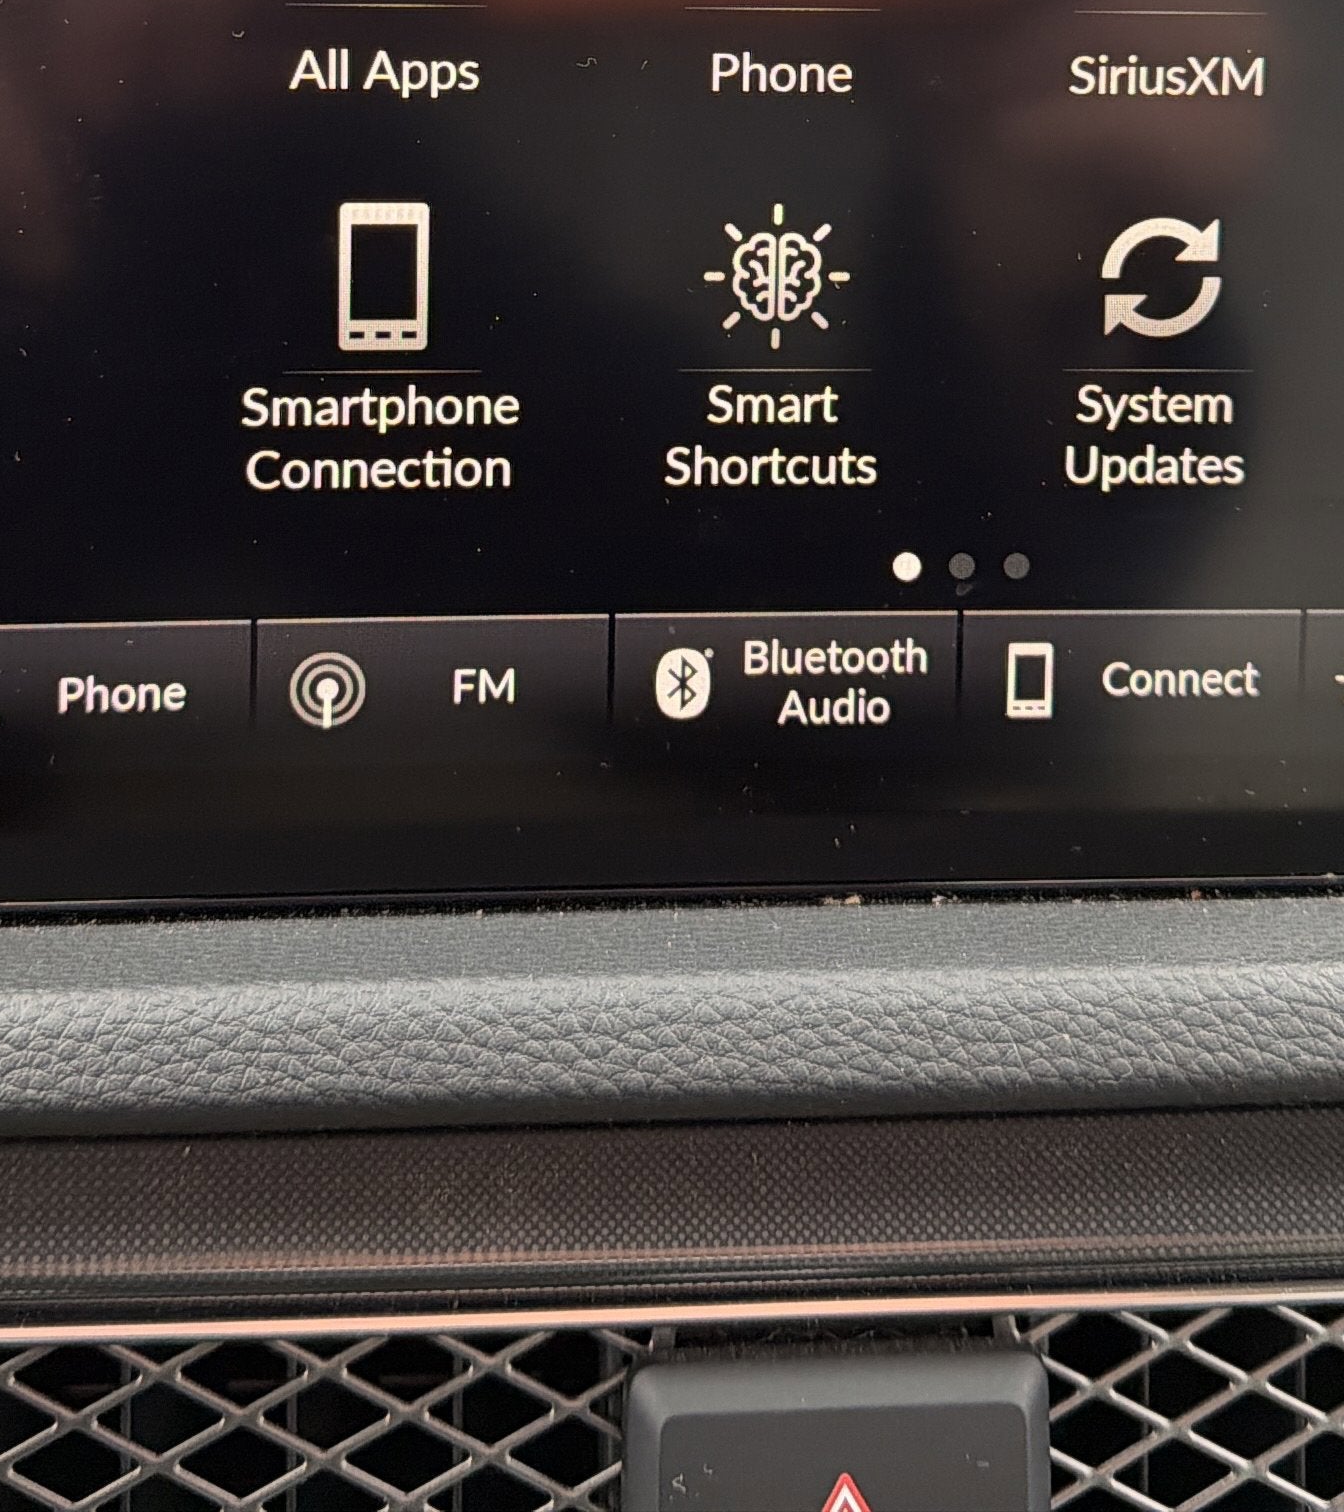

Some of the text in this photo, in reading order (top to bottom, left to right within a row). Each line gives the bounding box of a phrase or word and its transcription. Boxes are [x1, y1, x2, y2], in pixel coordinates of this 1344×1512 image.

[288, 47, 480, 99] All Apps
[711, 51, 853, 93] Phone
[1068, 56, 1265, 97] SiriusXM
[241, 384, 520, 434] Smartphone
[706, 384, 839, 424] Smart
[1075, 384, 1233, 431] System
[246, 446, 511, 490] Connection
[664, 444, 877, 486] Shortcuts
[1065, 443, 1245, 492] Updates
[743, 637, 928, 675] Bluetooth
[58, 674, 187, 714] Phone
[453, 667, 515, 705] FM
[1102, 661, 1261, 697] Connect
[777, 687, 891, 725] Audio
